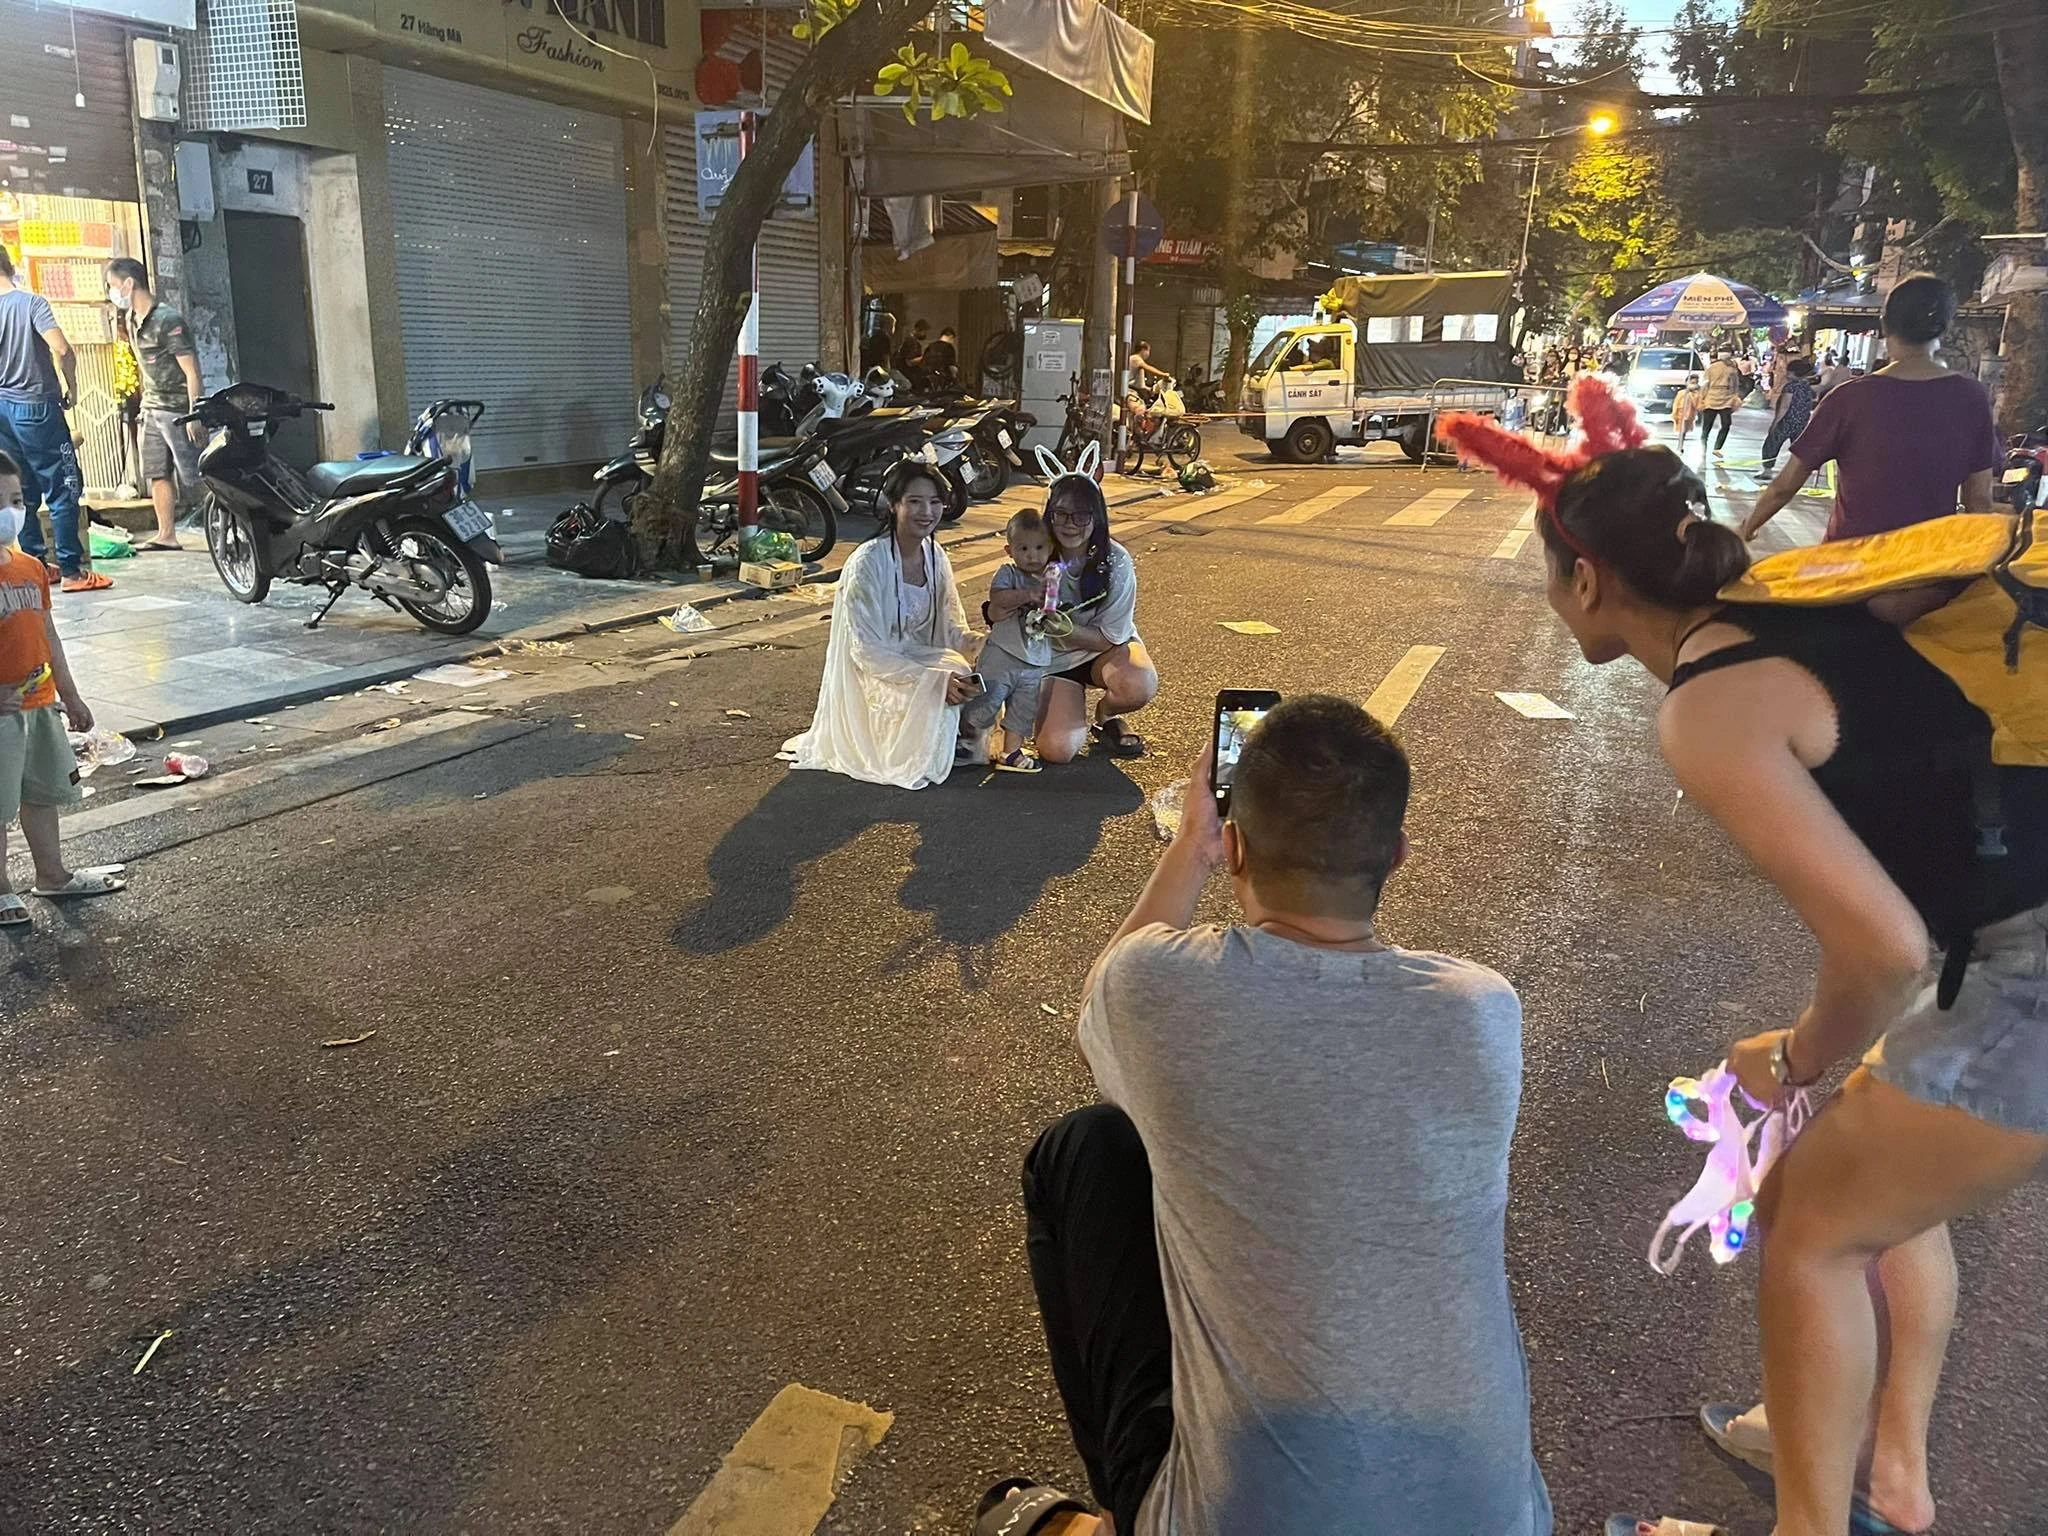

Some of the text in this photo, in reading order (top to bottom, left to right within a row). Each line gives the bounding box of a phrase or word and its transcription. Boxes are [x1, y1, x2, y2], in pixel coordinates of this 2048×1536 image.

[400, 14, 415, 30] 27
[516, 26, 606, 73] Fashion
[253, 174, 268, 190] 27
